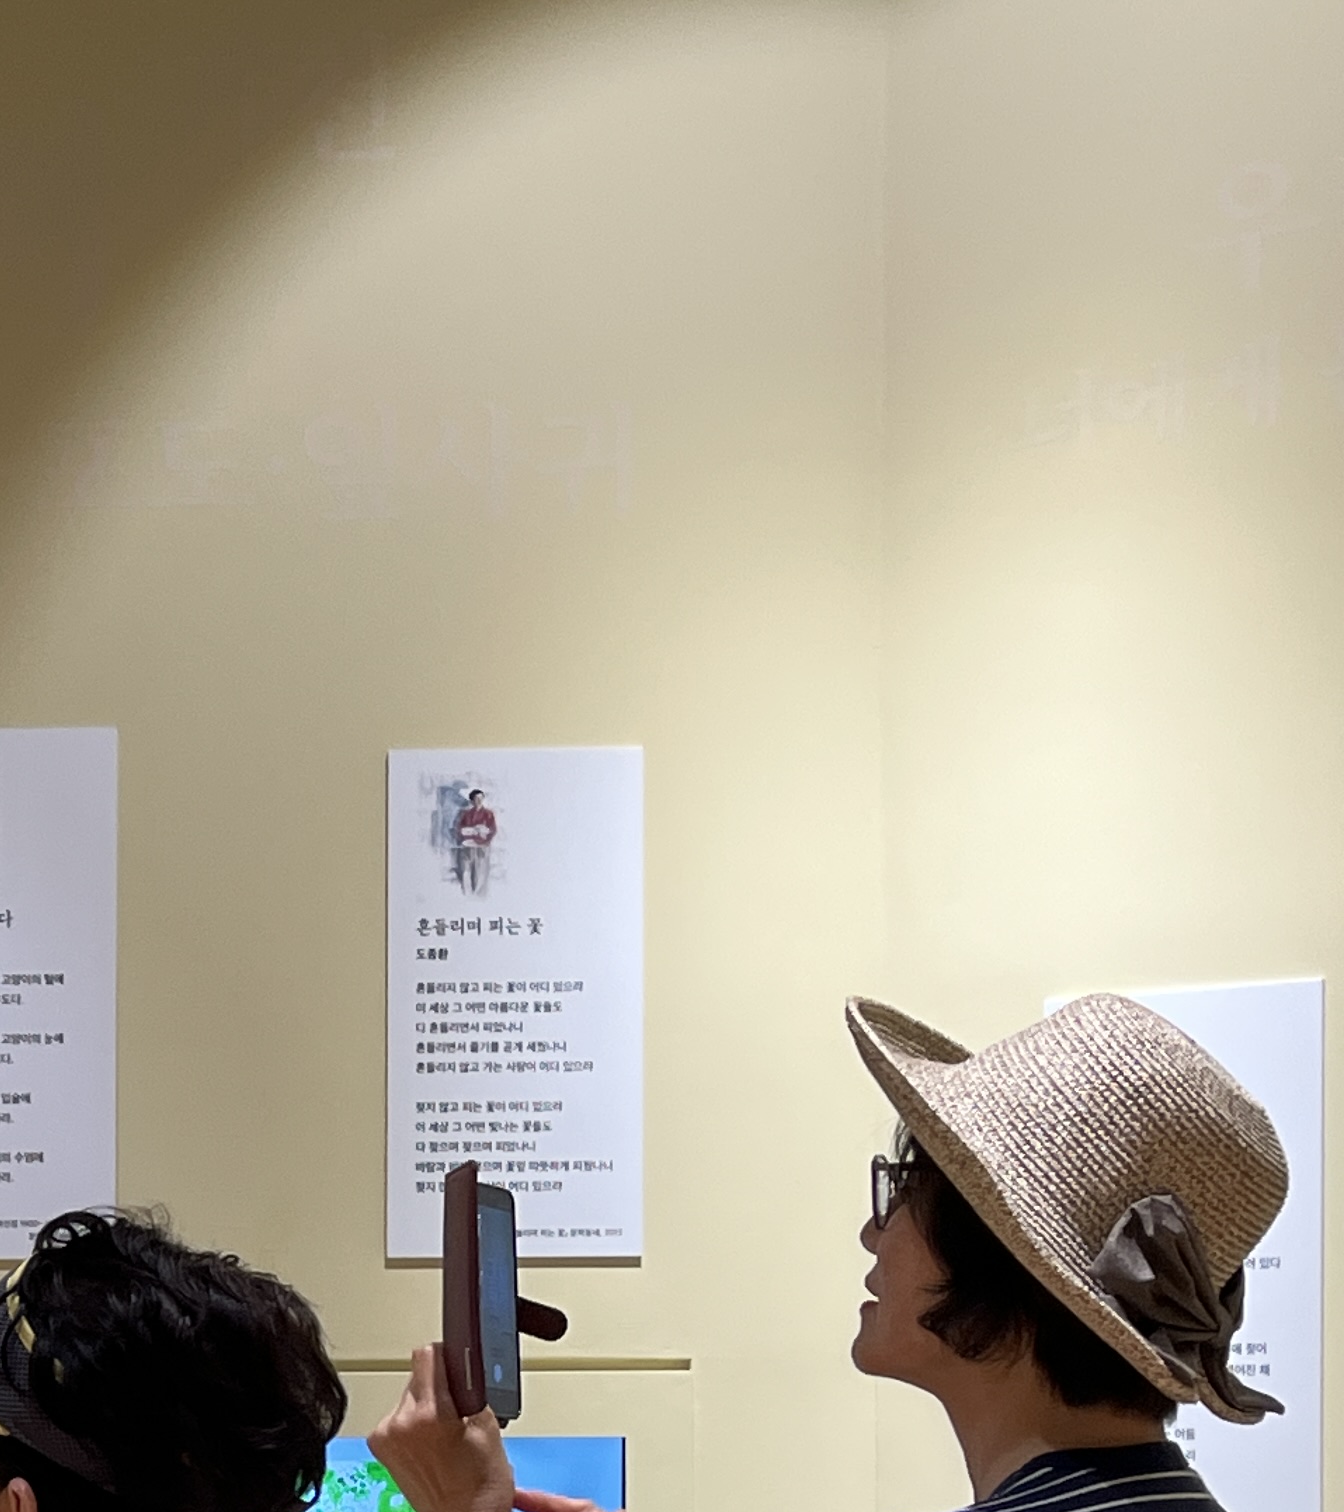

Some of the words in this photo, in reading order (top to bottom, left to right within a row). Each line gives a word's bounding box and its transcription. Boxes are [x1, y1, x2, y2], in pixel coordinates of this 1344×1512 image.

[416, 917, 481, 937] 흔들리며
[489, 916, 521, 936] 피는
[527, 918, 542, 935] 꽃
